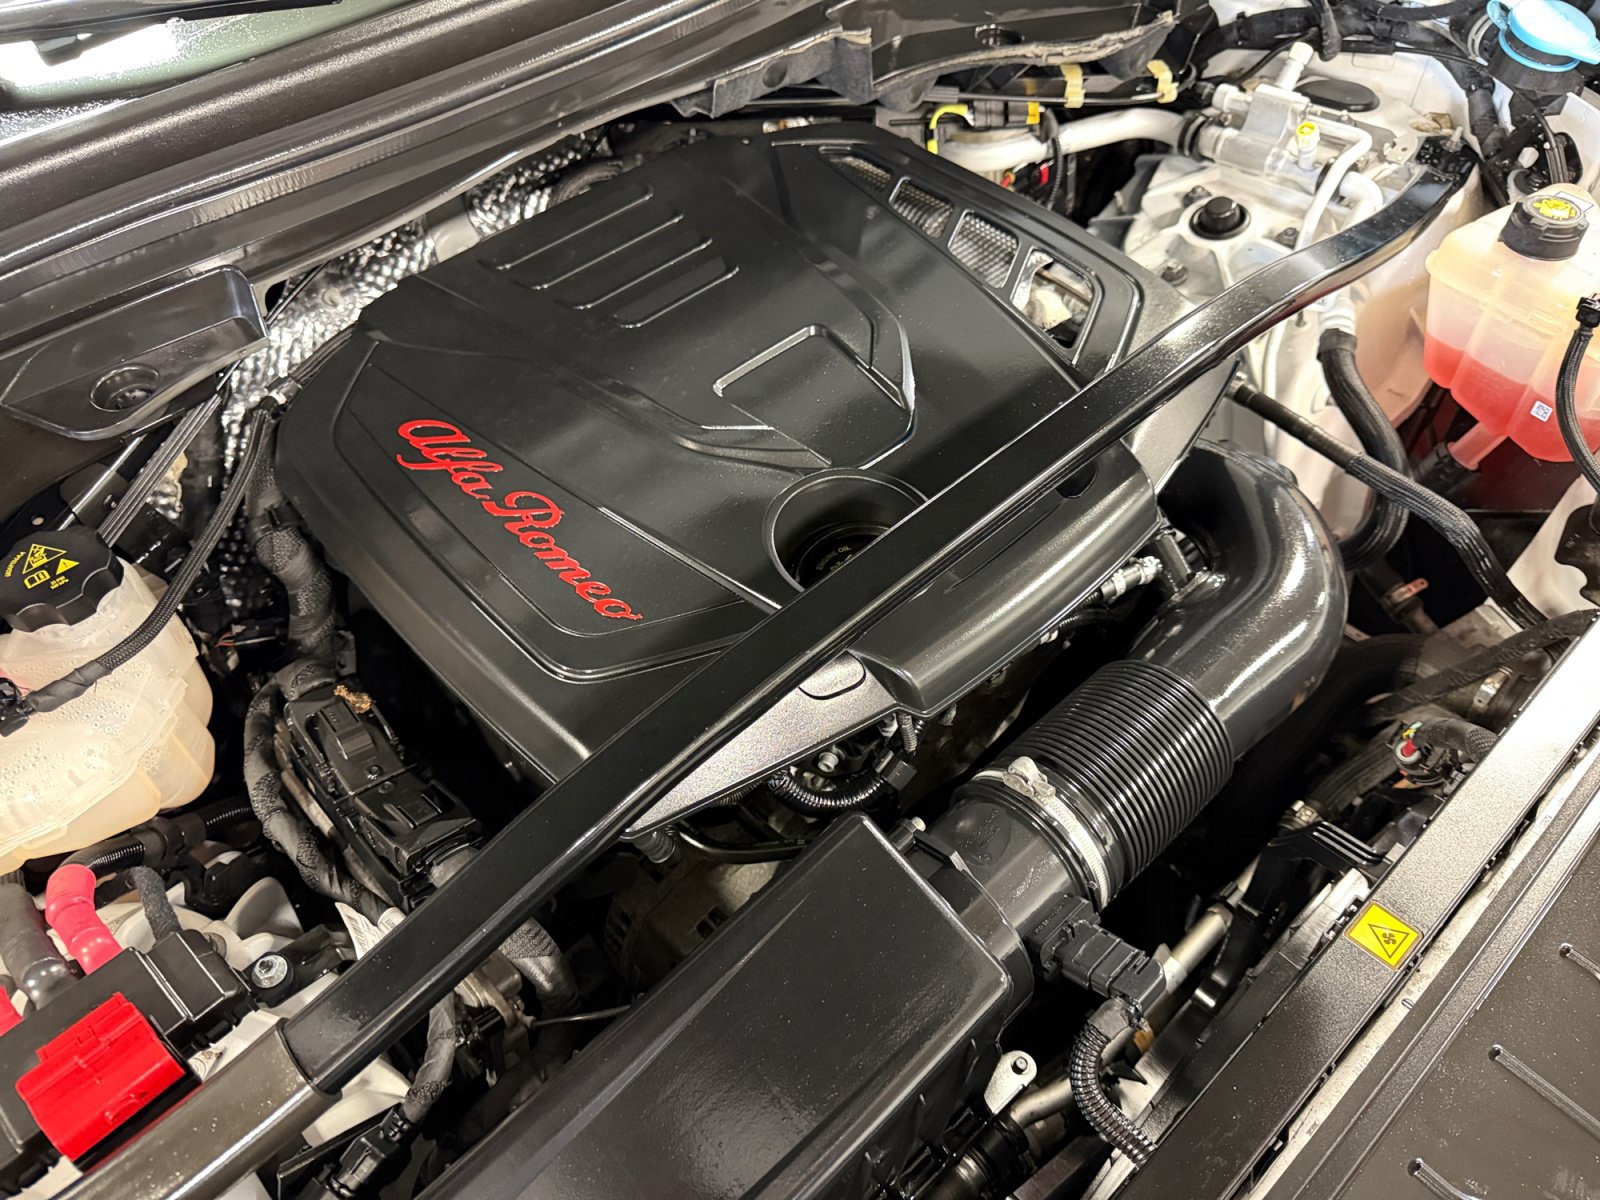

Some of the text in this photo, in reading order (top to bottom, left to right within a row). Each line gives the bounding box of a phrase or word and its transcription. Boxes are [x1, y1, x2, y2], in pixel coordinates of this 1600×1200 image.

[396, 419, 643, 620] Alfa Romeo
[838, 545, 852, 553] OIL
